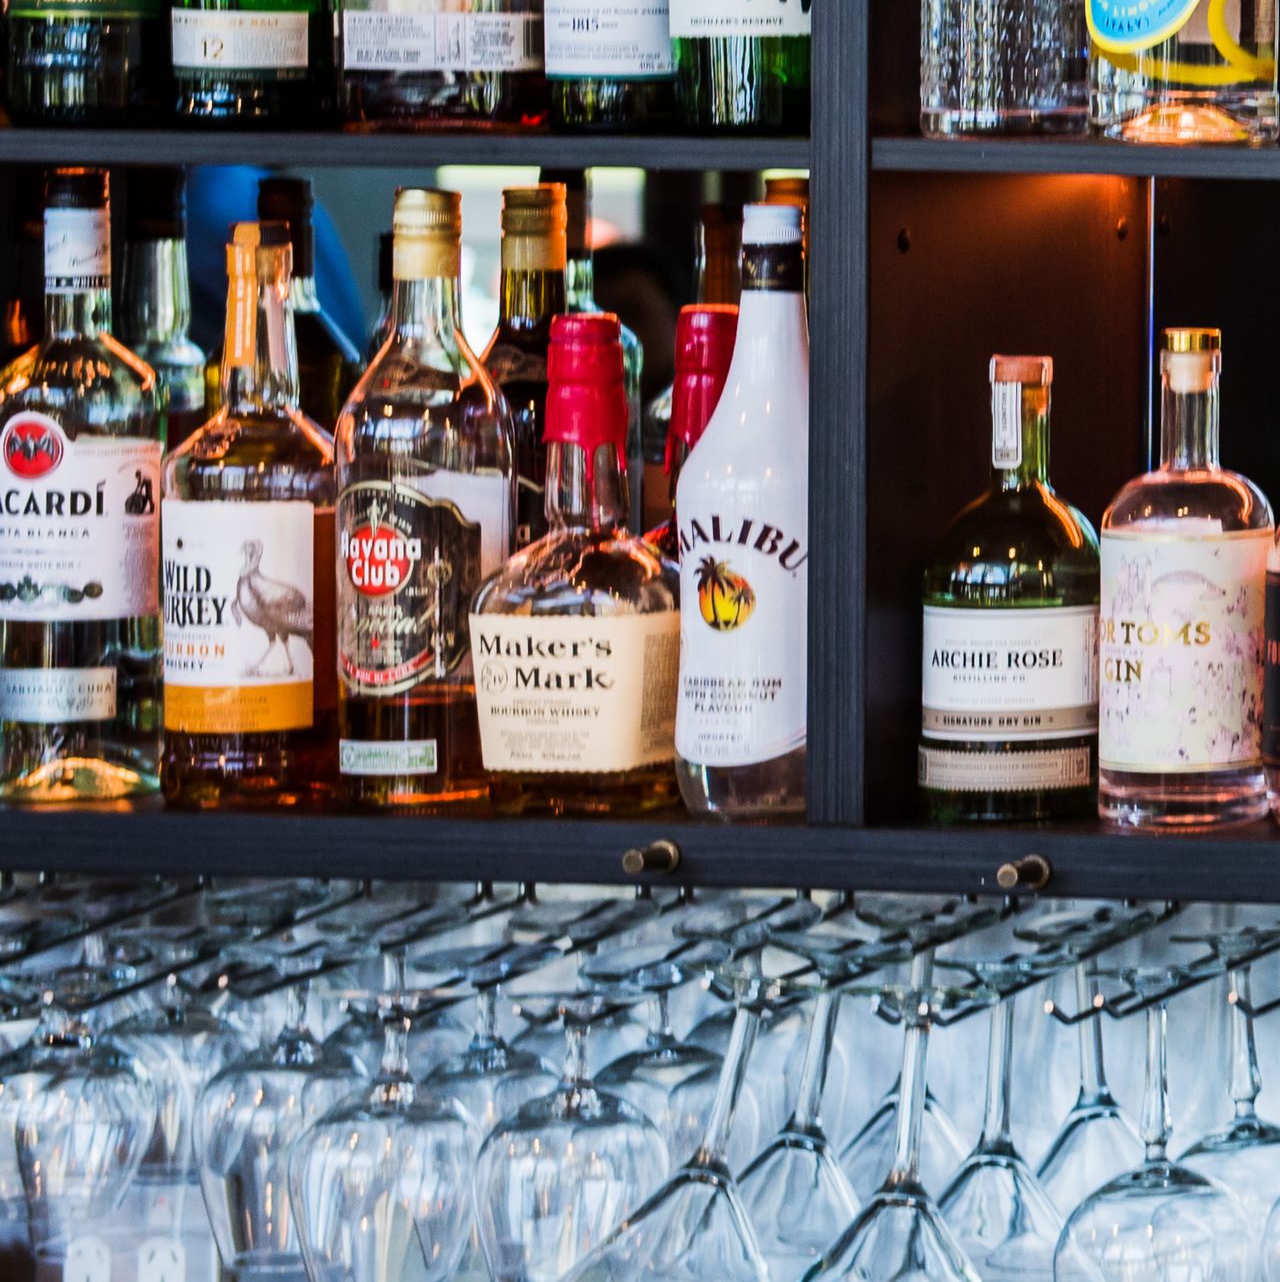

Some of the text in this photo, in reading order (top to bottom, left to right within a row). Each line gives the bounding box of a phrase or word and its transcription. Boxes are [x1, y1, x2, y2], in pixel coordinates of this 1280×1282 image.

[571, 17, 600, 33] 1815
[742, 17, 784, 27] RESERVE
[200, 37, 223, 61] 12
[0, 479, 107, 516] ACARDÍ
[341, 531, 421, 561] Havana
[680, 515, 808, 572] MALIBU
[165, 558, 211, 594] WILD
[352, 558, 401, 587] Club
[164, 595, 228, 628] URKEY
[480, 634, 612, 658] Maker's
[1121, 621, 1212, 647] TOMS
[931, 649, 1063, 669] ARCHIE ROSE
[1105, 658, 1143, 682] GIN
[514, 667, 615, 690] Mark
[752, 677, 782, 688] RUM
[685, 691, 777, 702] WITH COCONUT
[490, 707, 600, 717] BOURBON WHISKY
[694, 704, 753, 714] FLAVOUR
[943, 715, 1042, 727] SIGNATURE DRY GIN
